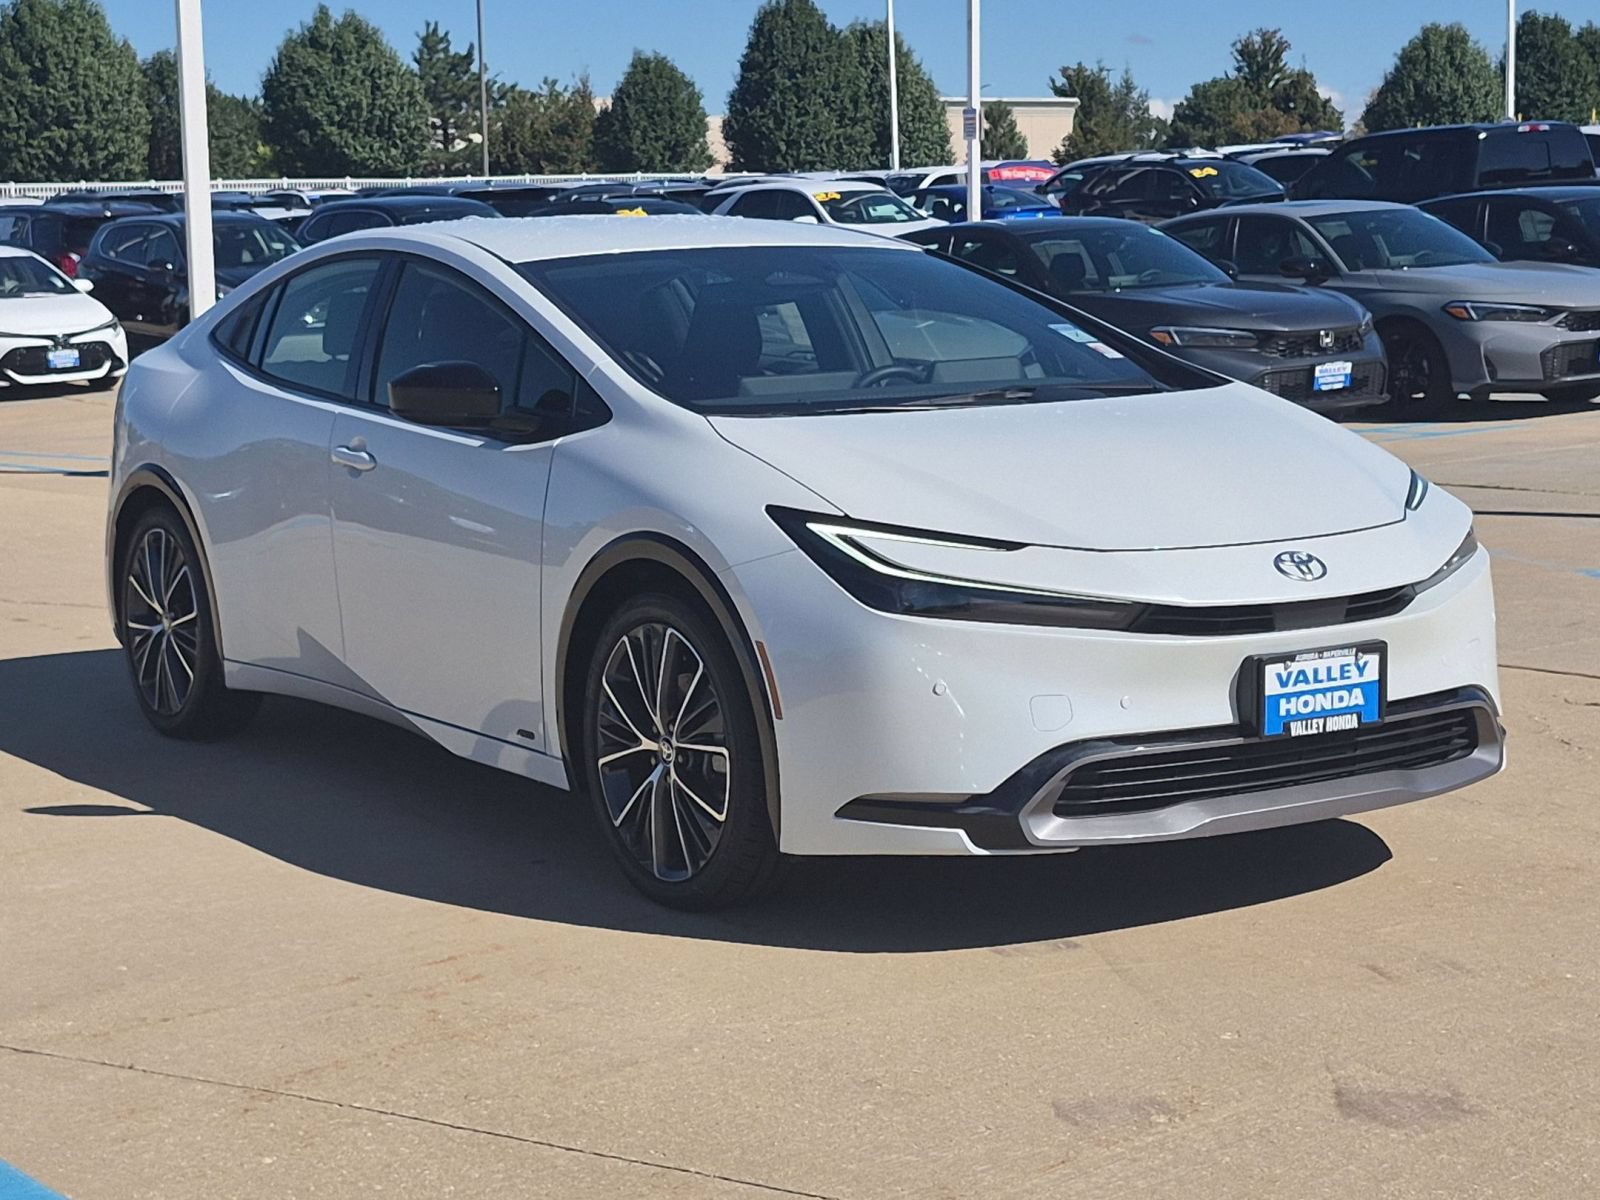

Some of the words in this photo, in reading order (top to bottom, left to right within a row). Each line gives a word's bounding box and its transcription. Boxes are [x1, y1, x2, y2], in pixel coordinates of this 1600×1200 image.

[1275, 660, 1369, 689] VALLEY
[1279, 687, 1365, 717] HONDA
[1290, 717, 1324, 737] VALLEY
[1325, 713, 1359, 733] HONDA
